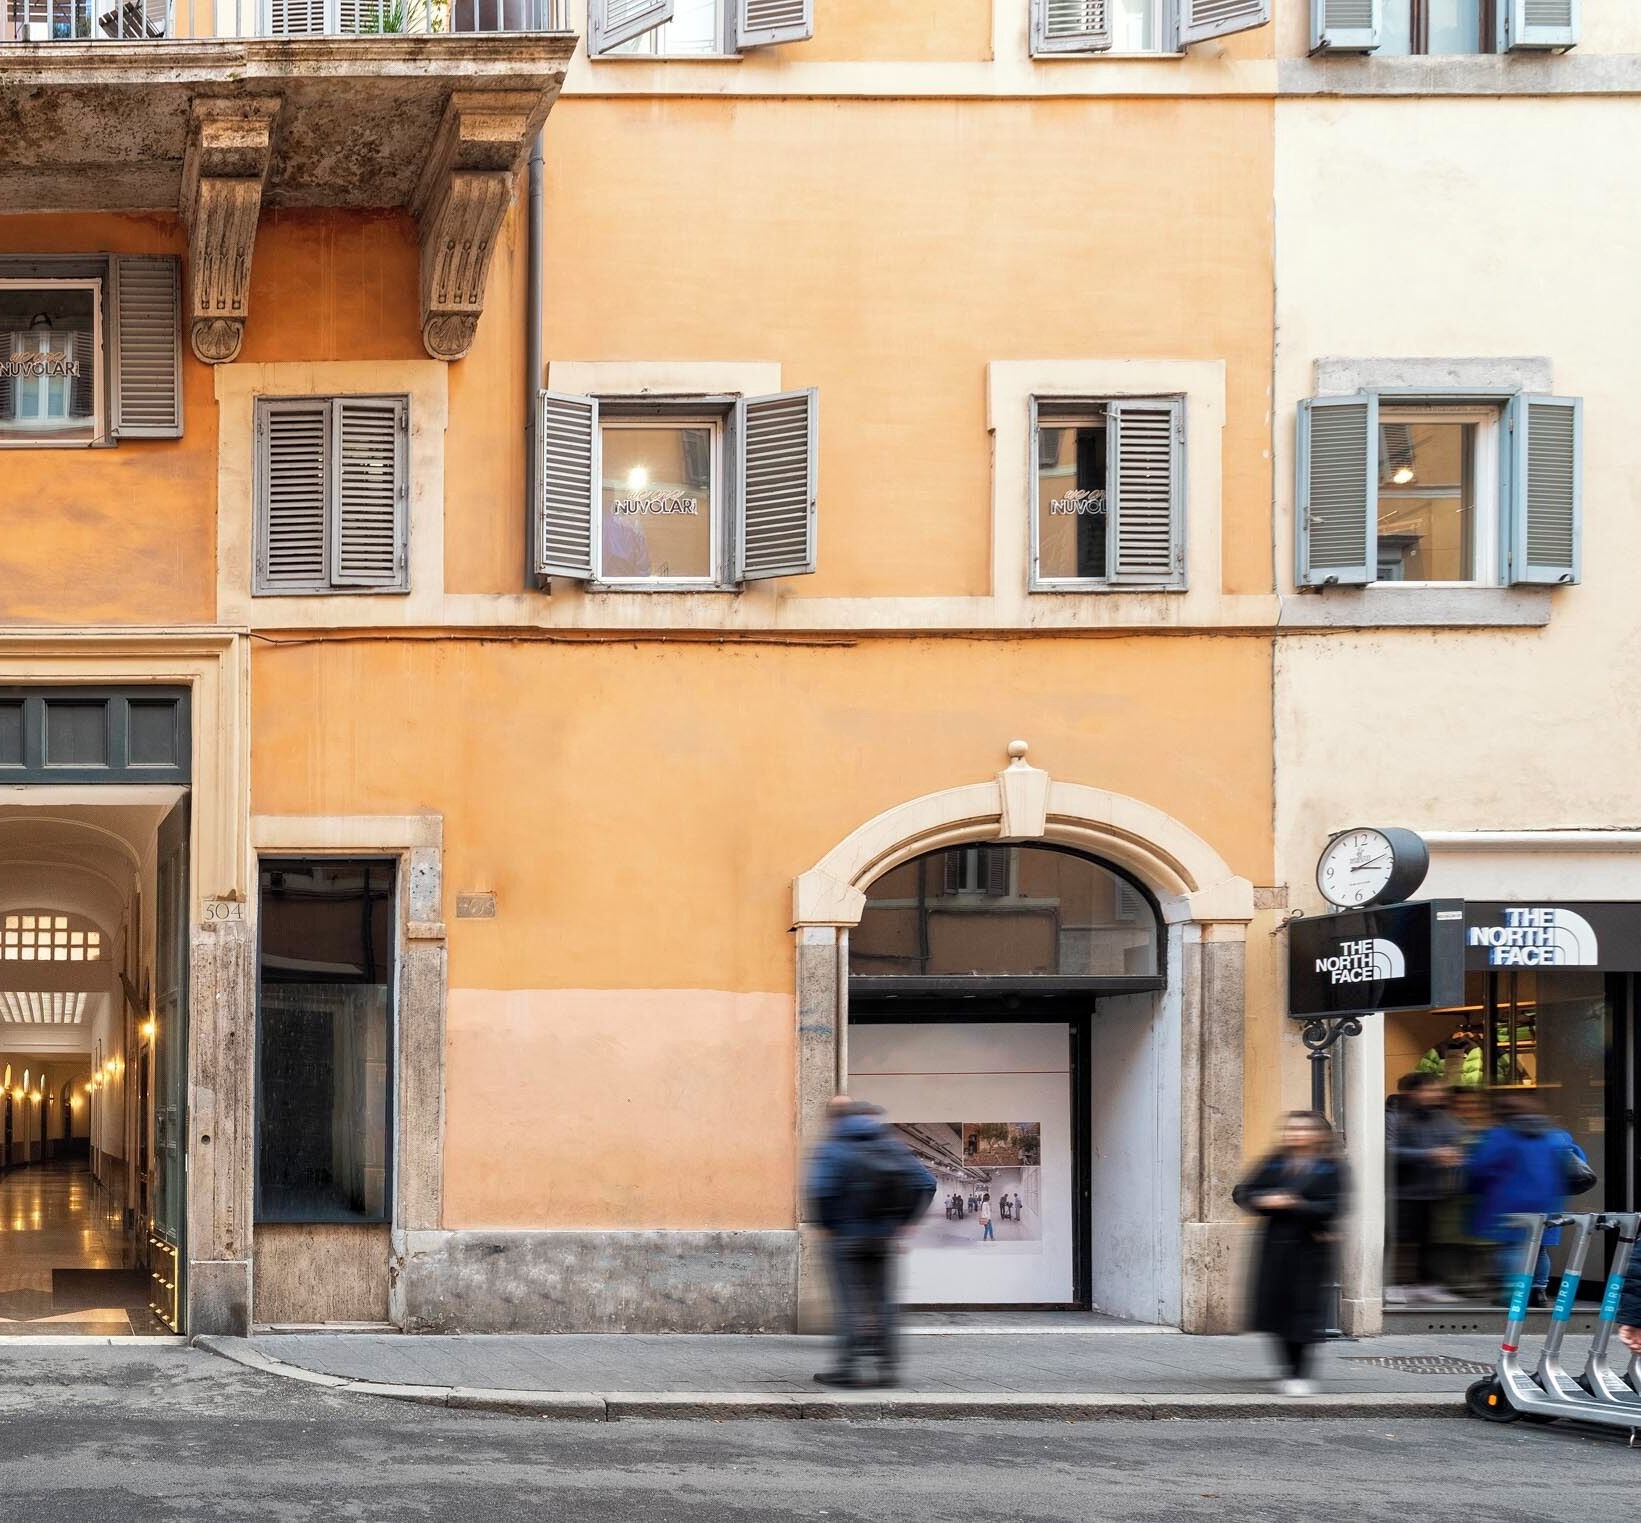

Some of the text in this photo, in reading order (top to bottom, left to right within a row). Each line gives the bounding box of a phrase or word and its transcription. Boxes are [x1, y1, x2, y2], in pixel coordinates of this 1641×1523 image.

[614, 498, 697, 516] NUVOLARI
[1354, 833, 1368, 848] 12
[1326, 867, 1335, 880] 9
[1355, 889, 1363, 902] 6
[205, 903, 242, 920] 504
[1504, 908, 1554, 927] THE
[1468, 926, 1554, 946] NORTH
[1340, 939, 1373, 956] THE
[1491, 946, 1553, 965] FACE
[1315, 953, 1373, 973] NORTH
[1331, 966, 1373, 984] FACE
[1511, 1280, 1525, 1313] BIRD
[1554, 1280, 1570, 1312] BIRD
[1604, 1283, 1620, 1312] BIRD
